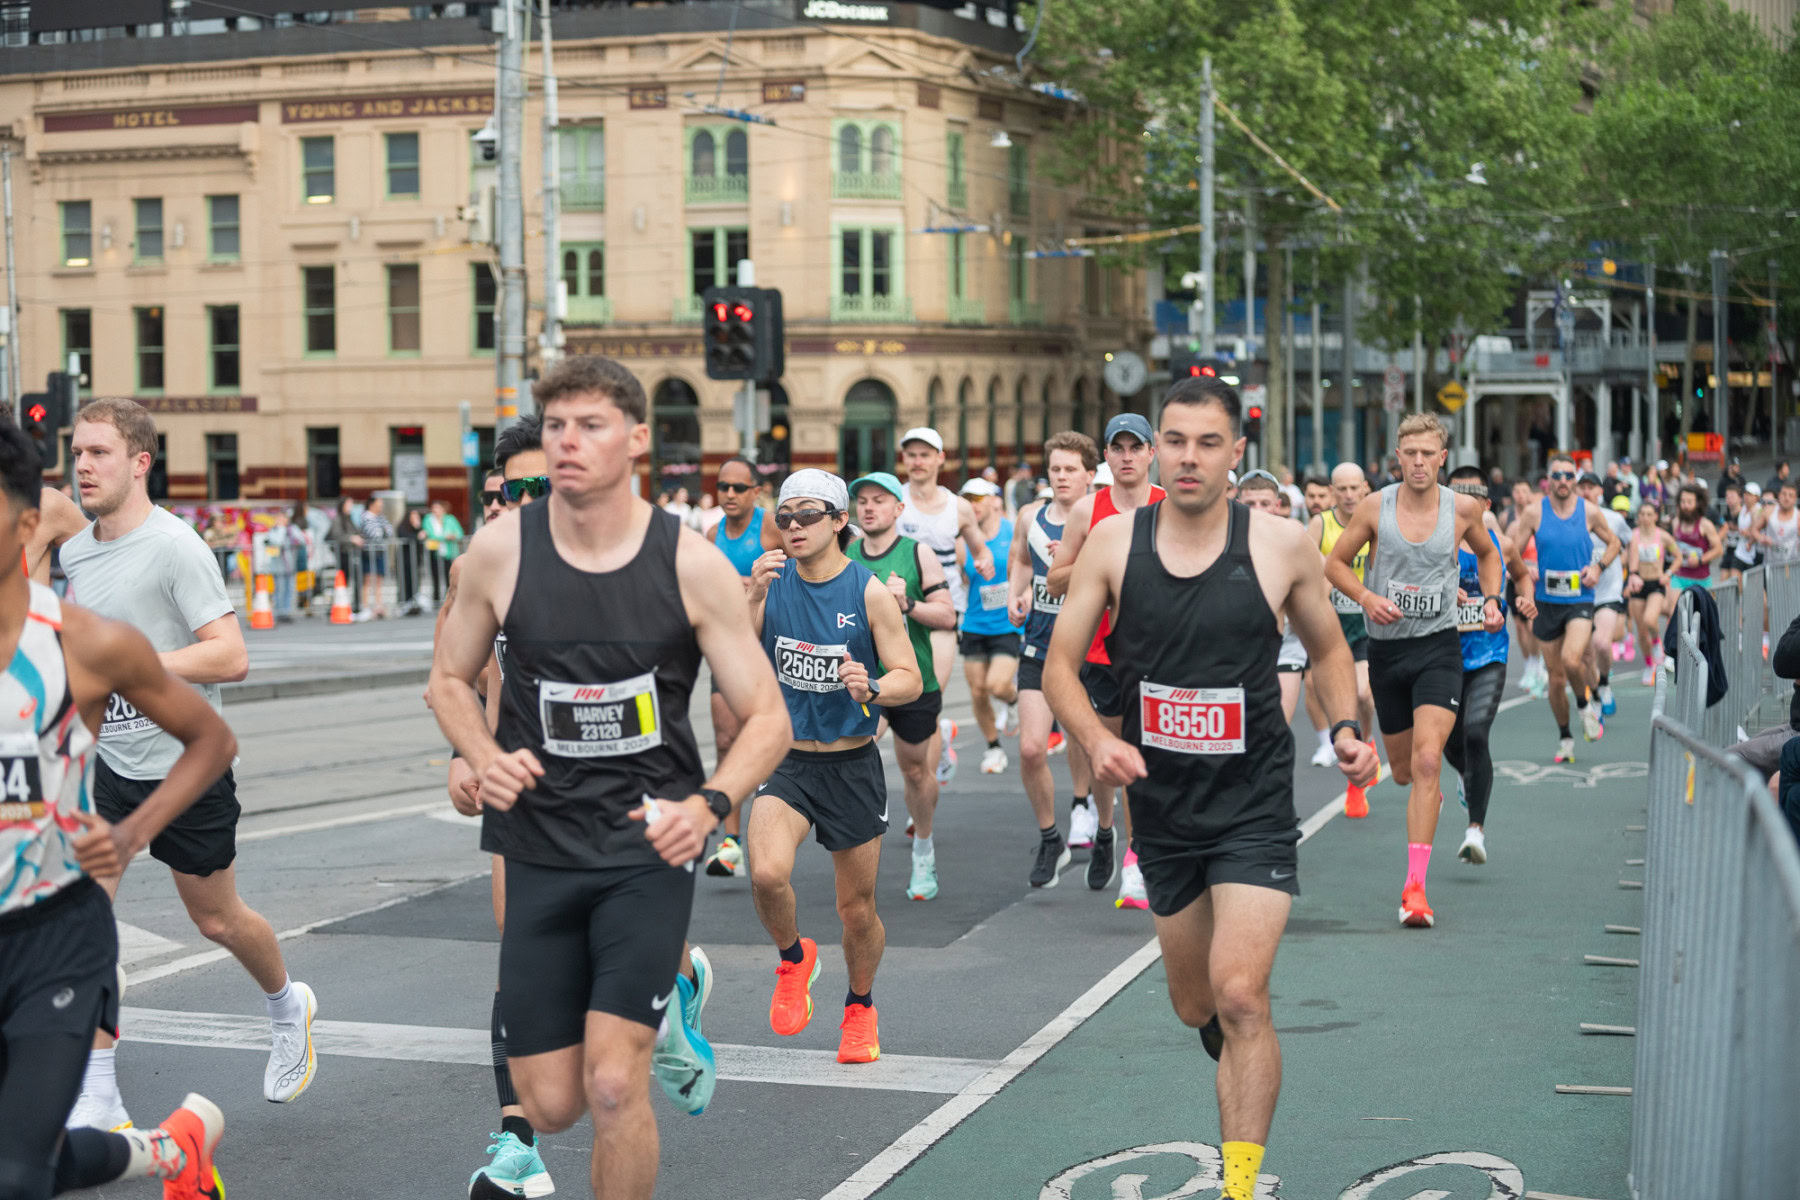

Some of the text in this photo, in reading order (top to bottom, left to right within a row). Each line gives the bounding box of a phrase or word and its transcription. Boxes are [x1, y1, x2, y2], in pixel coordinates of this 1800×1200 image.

[287, 96, 494, 120] YOUNG AND JACKSO
[113, 112, 180, 128] HOTEL
[1394, 592, 1434, 611] 36151
[782, 651, 840, 682] 25664
[783, 675, 818, 691] MELBOURNE
[572, 704, 624, 723] HARVEY
[1158, 702, 1225, 738] 8550
[580, 722, 622, 741] 23120
[557, 738, 650, 753] MELBOURNE 2025
[1151, 735, 1233, 751] MELBOURNE 2025
